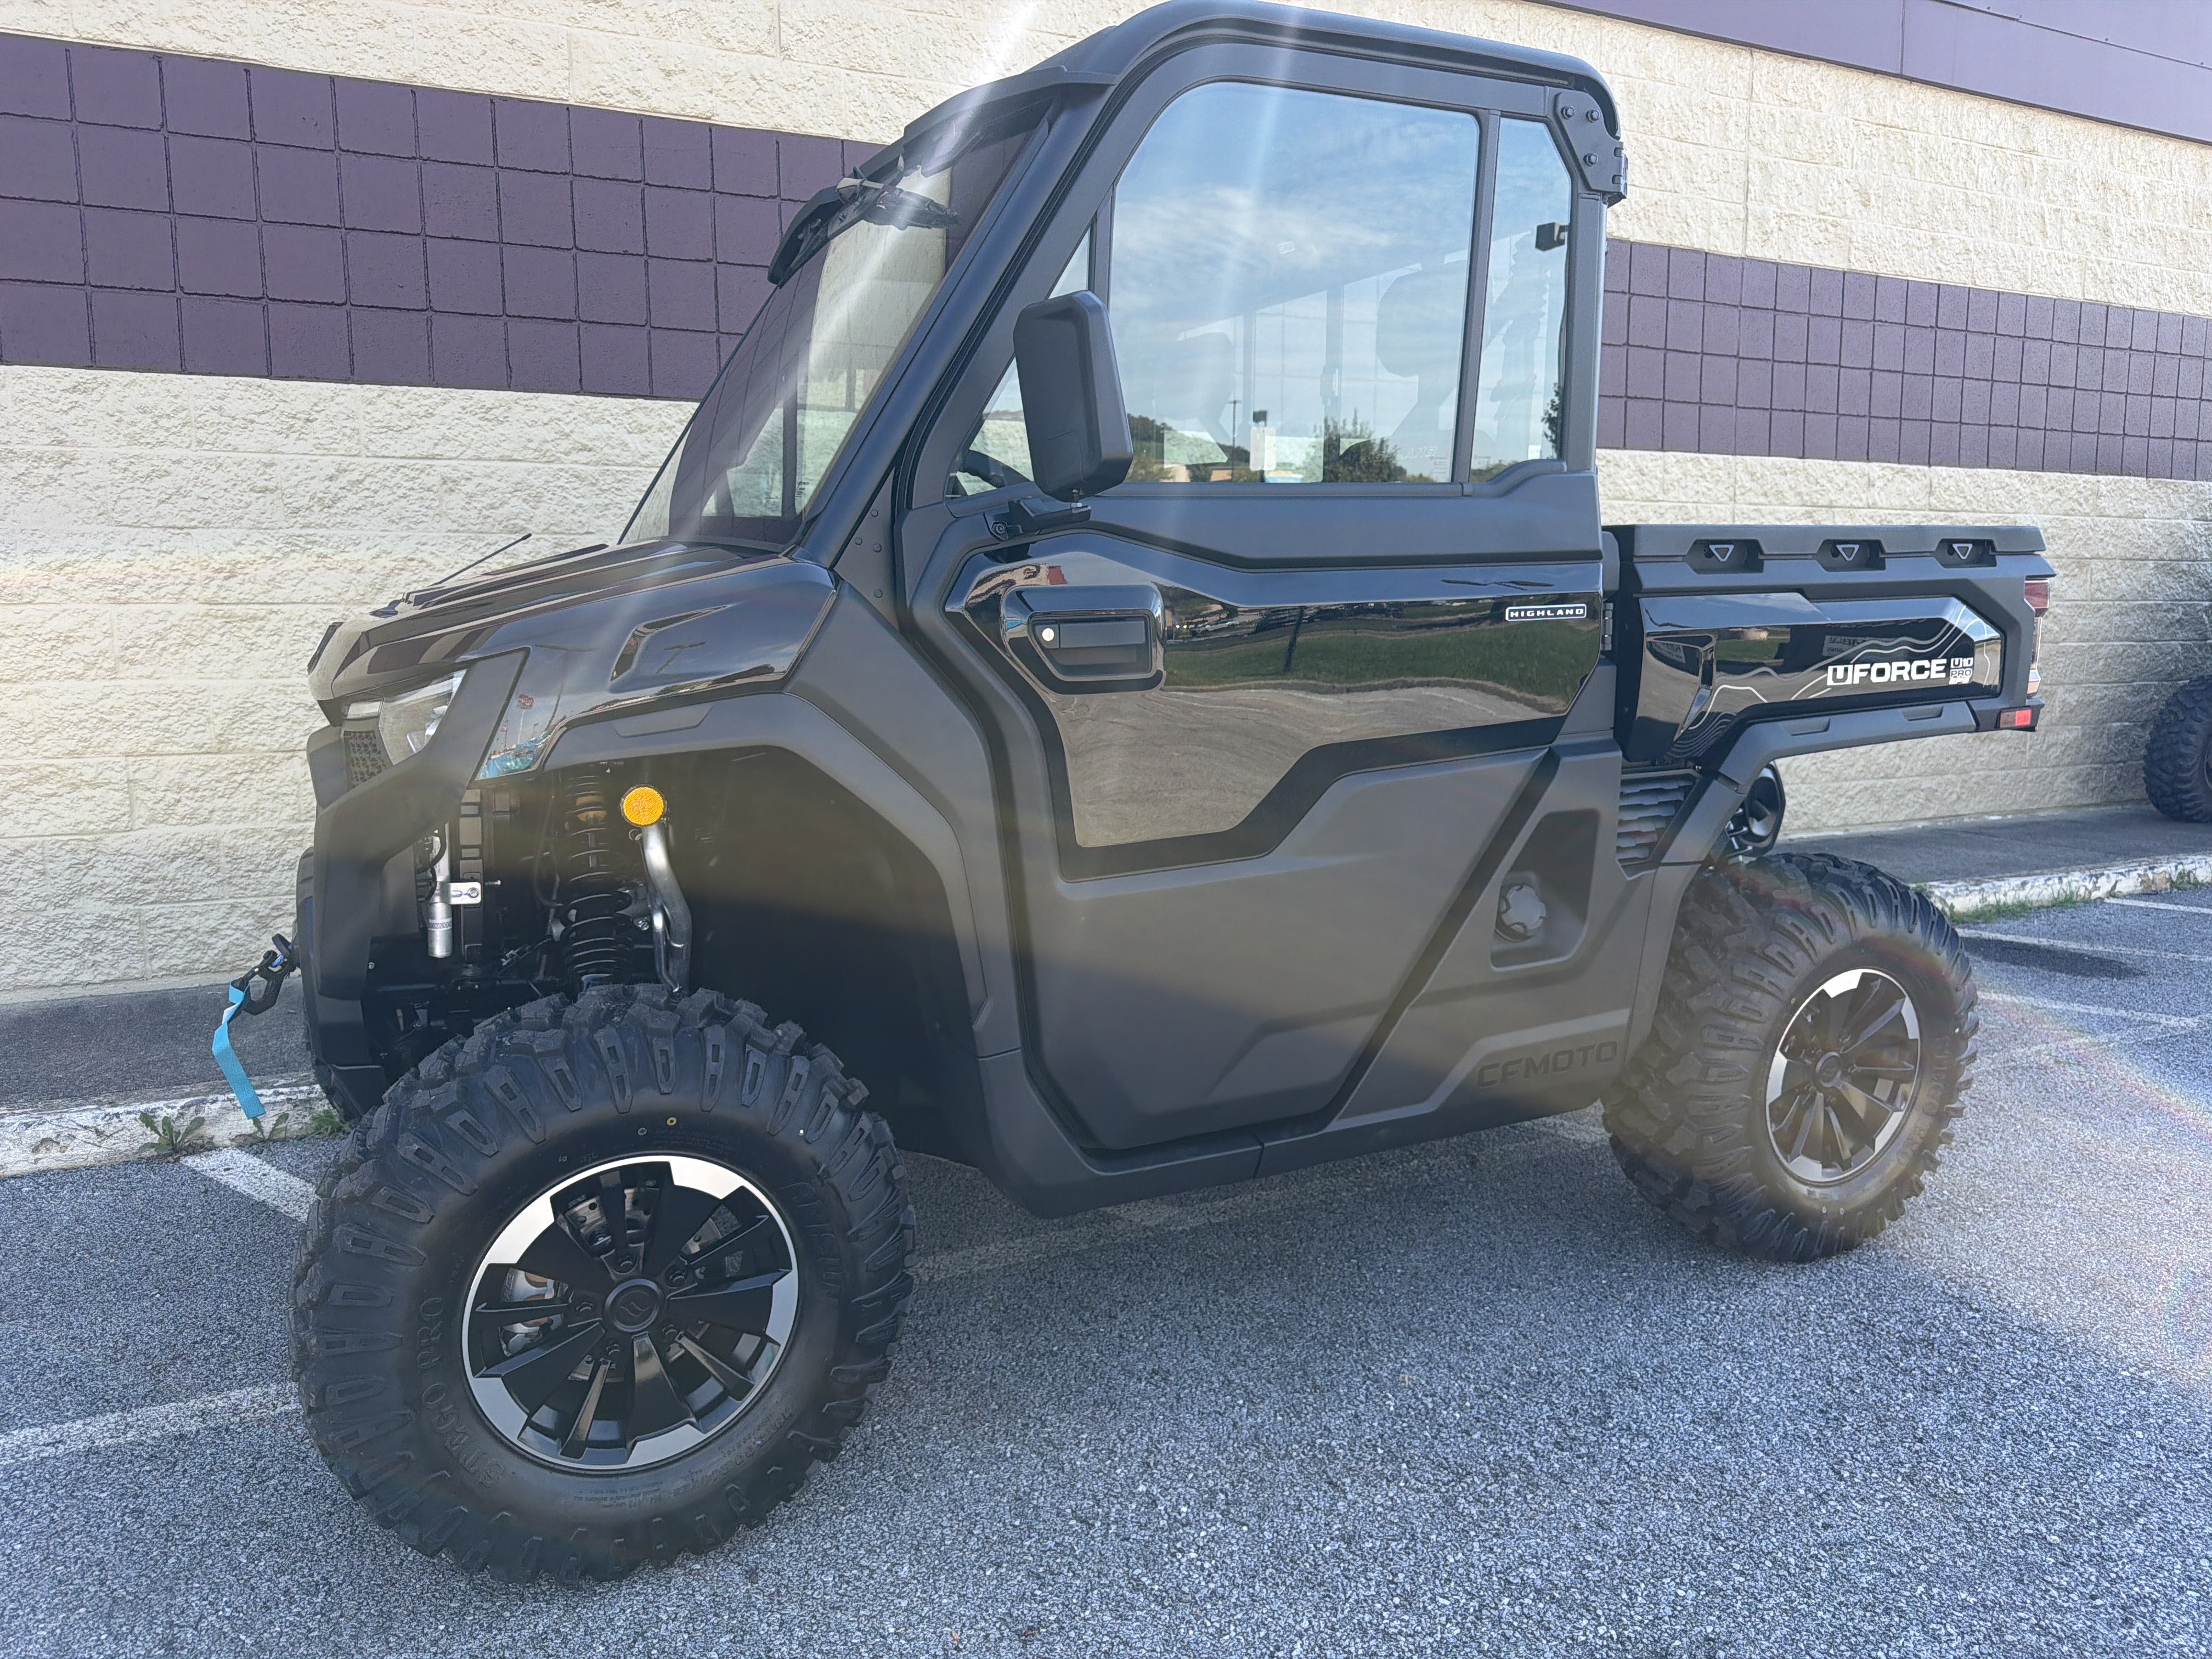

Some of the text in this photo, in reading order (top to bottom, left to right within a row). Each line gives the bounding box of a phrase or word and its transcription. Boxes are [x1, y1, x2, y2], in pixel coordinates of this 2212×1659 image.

[1510, 608, 1584, 618] HIGHLAND
[1827, 658, 1948, 686] UFORCE
[1950, 657, 1973, 668] U10
[1950, 668, 1973, 678] PRO
[1477, 1041, 1618, 1088] CFMOTO
[416, 1297, 506, 1488] STEGO PRO
